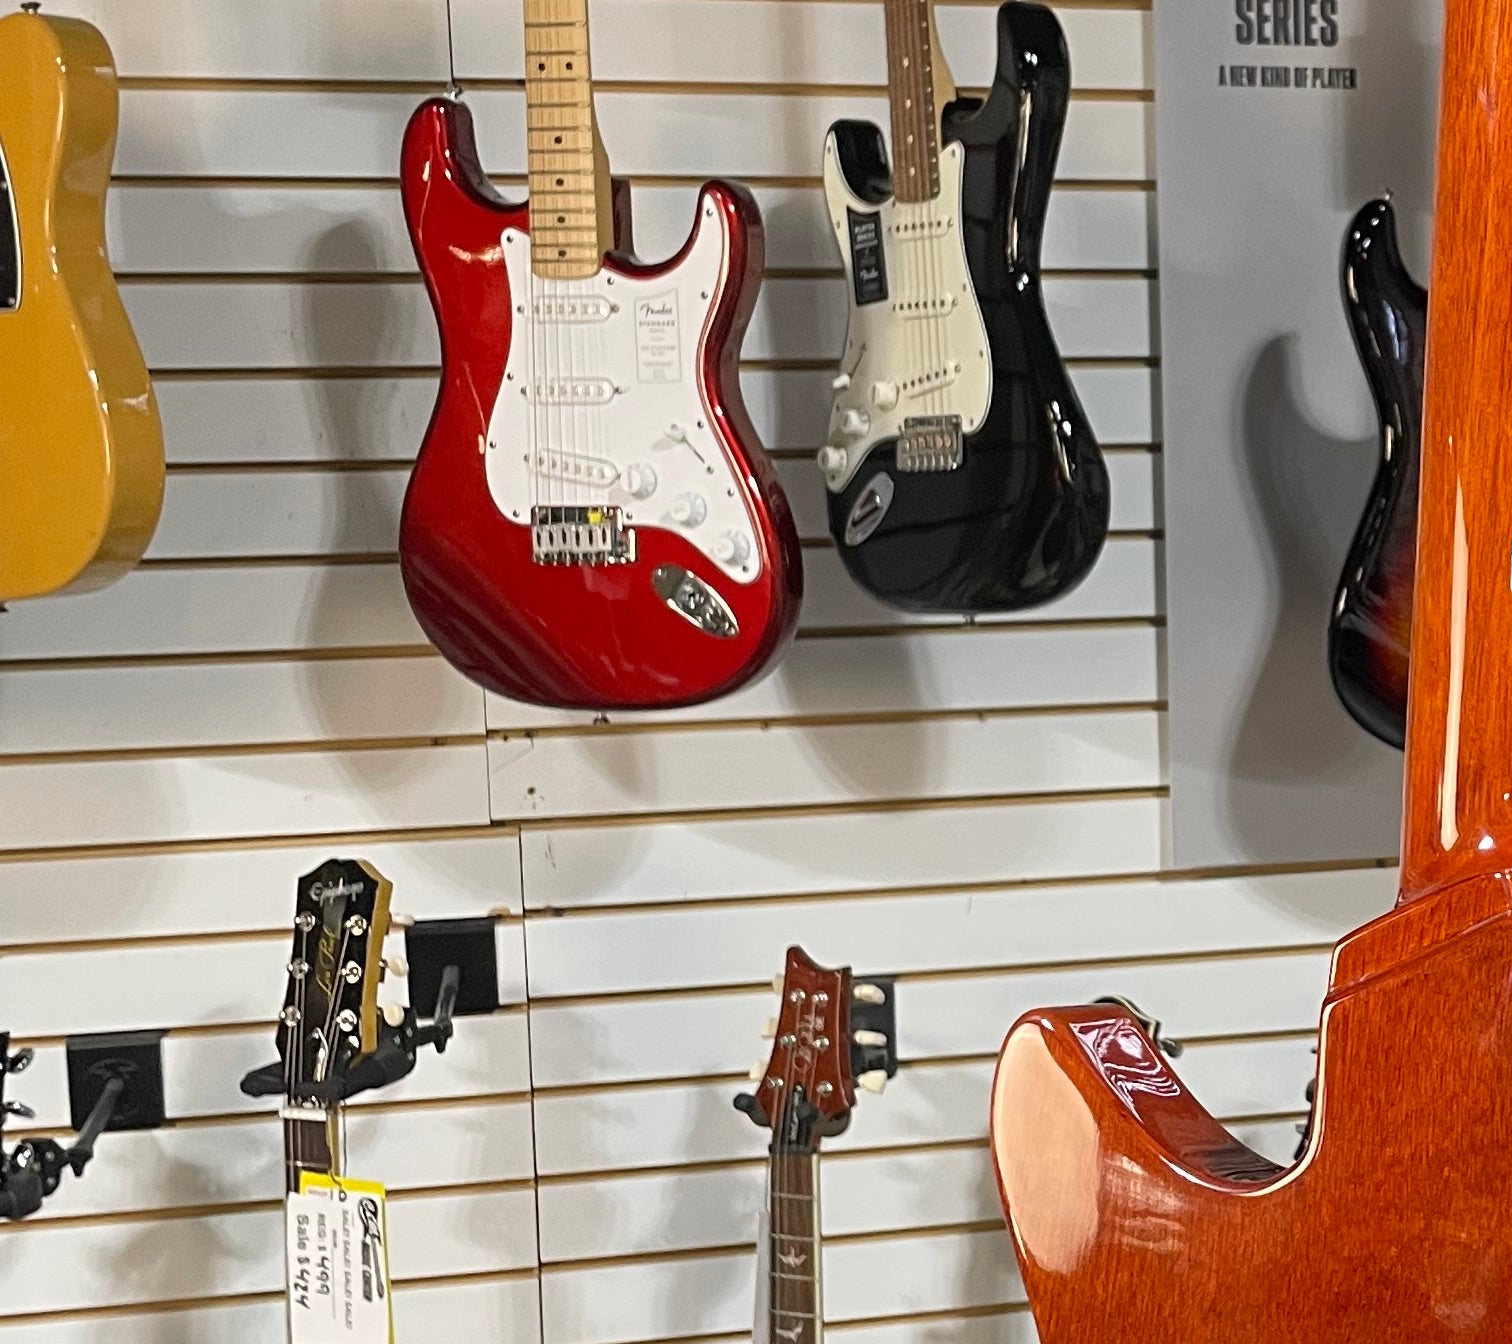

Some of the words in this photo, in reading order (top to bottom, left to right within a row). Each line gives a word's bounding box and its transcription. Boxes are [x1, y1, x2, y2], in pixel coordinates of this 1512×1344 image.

[1218, 65, 1227, 87] A
[1230, 65, 1257, 87] NEW
[1261, 66, 1290, 88] KIND
[1294, 67, 1308, 88] OF
[1312, 67, 1357, 89] PLAYER
[296, 1214, 309, 1249] Sale
